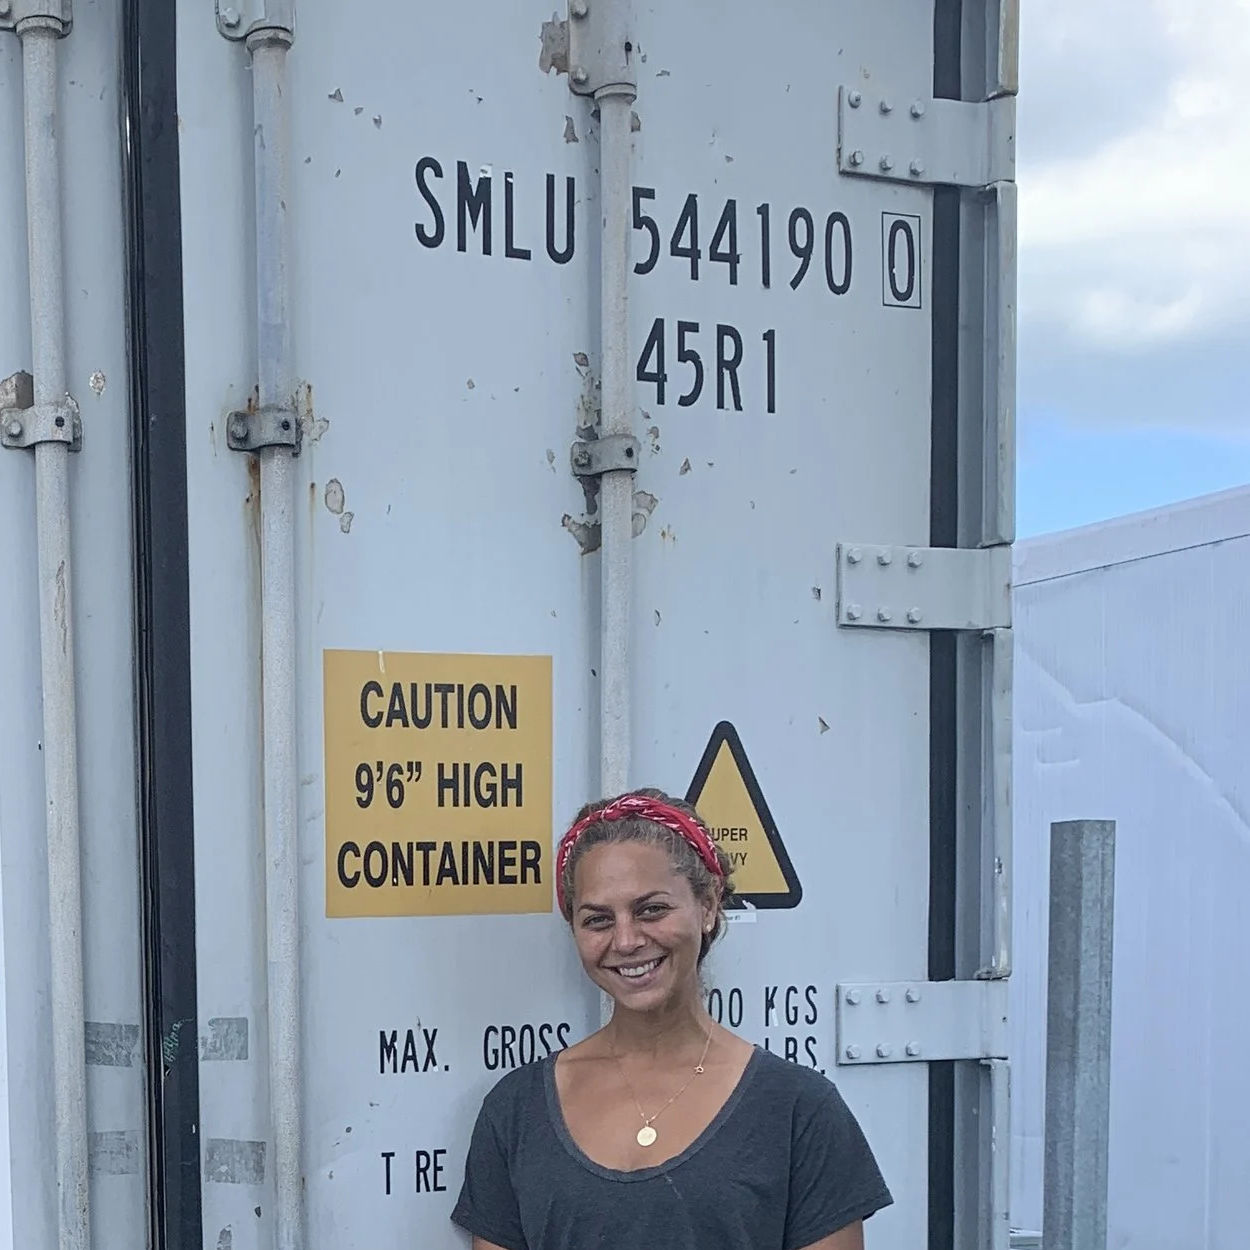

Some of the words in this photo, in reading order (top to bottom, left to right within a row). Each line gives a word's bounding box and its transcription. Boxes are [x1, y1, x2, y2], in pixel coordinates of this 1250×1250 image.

[415, 156, 576, 265] SMLU
[632, 186, 853, 296] 544190
[888, 219, 916, 302] 0
[636, 318, 776, 414] 45R1
[360, 680, 517, 729] CAUTION
[437, 761, 523, 808] HIGH
[711, 828, 748, 841] UPER
[337, 840, 542, 888] CONTAINER
[765, 985, 818, 1027] KGS
[379, 1028, 450, 1074] MAX.
[483, 1022, 571, 1071] GROSS
